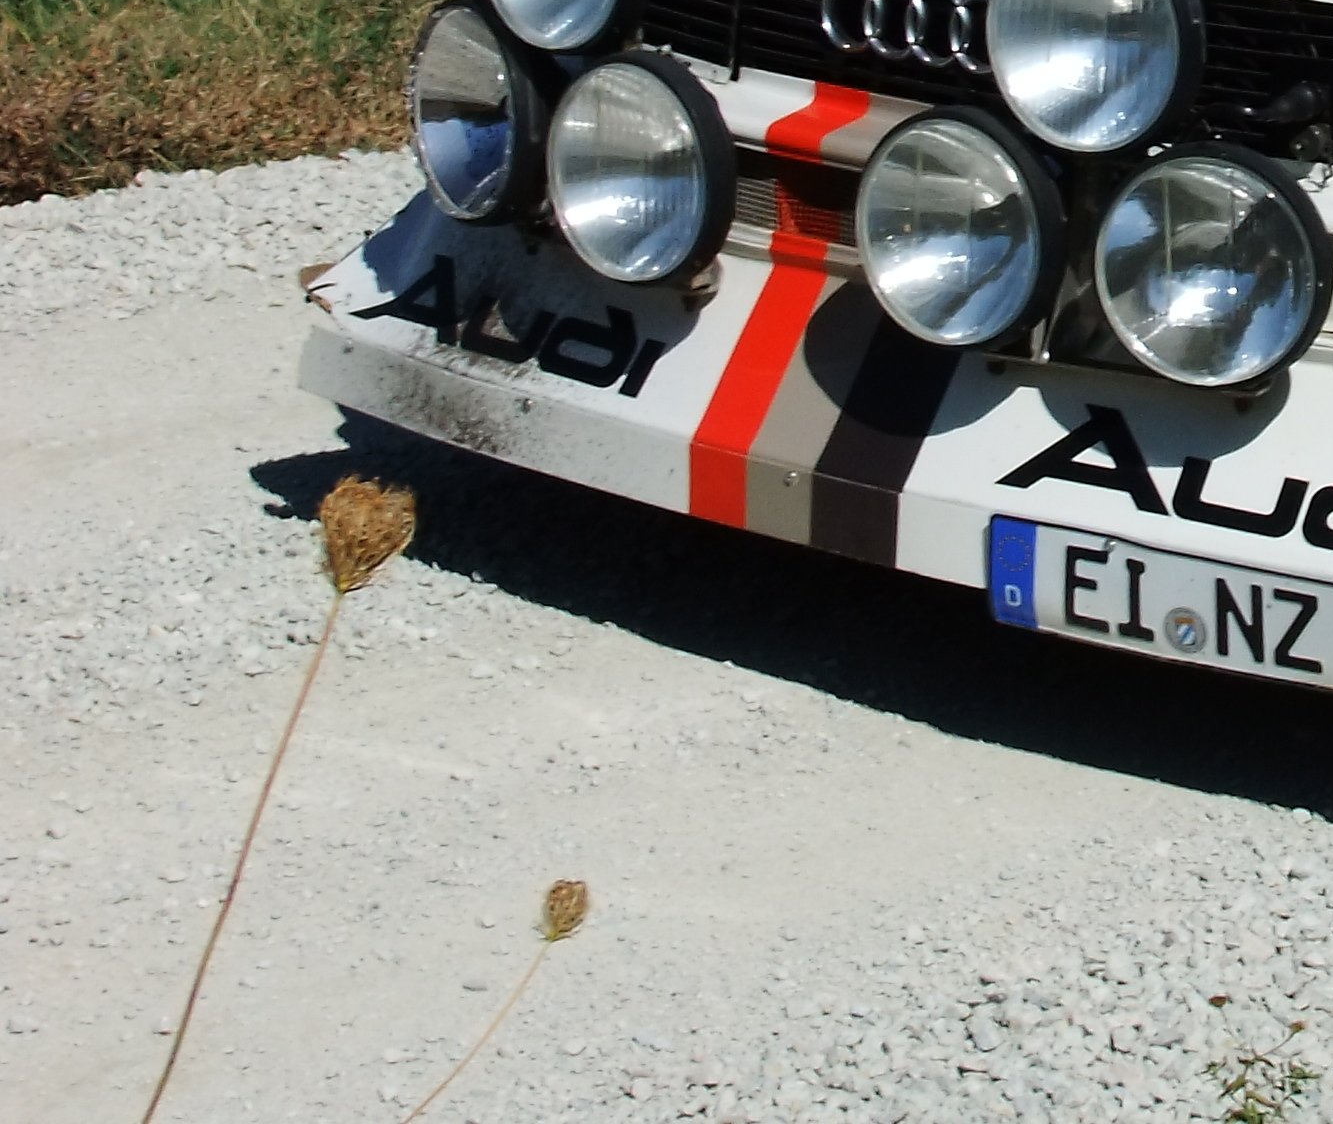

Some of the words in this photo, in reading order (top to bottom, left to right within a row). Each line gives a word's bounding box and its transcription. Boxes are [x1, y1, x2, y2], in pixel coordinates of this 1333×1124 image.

[349, 254, 667, 399] Audi
[1004, 583, 1022, 608] D
[1065, 544, 1155, 642] EI
[1214, 577, 1323, 675] NZ
